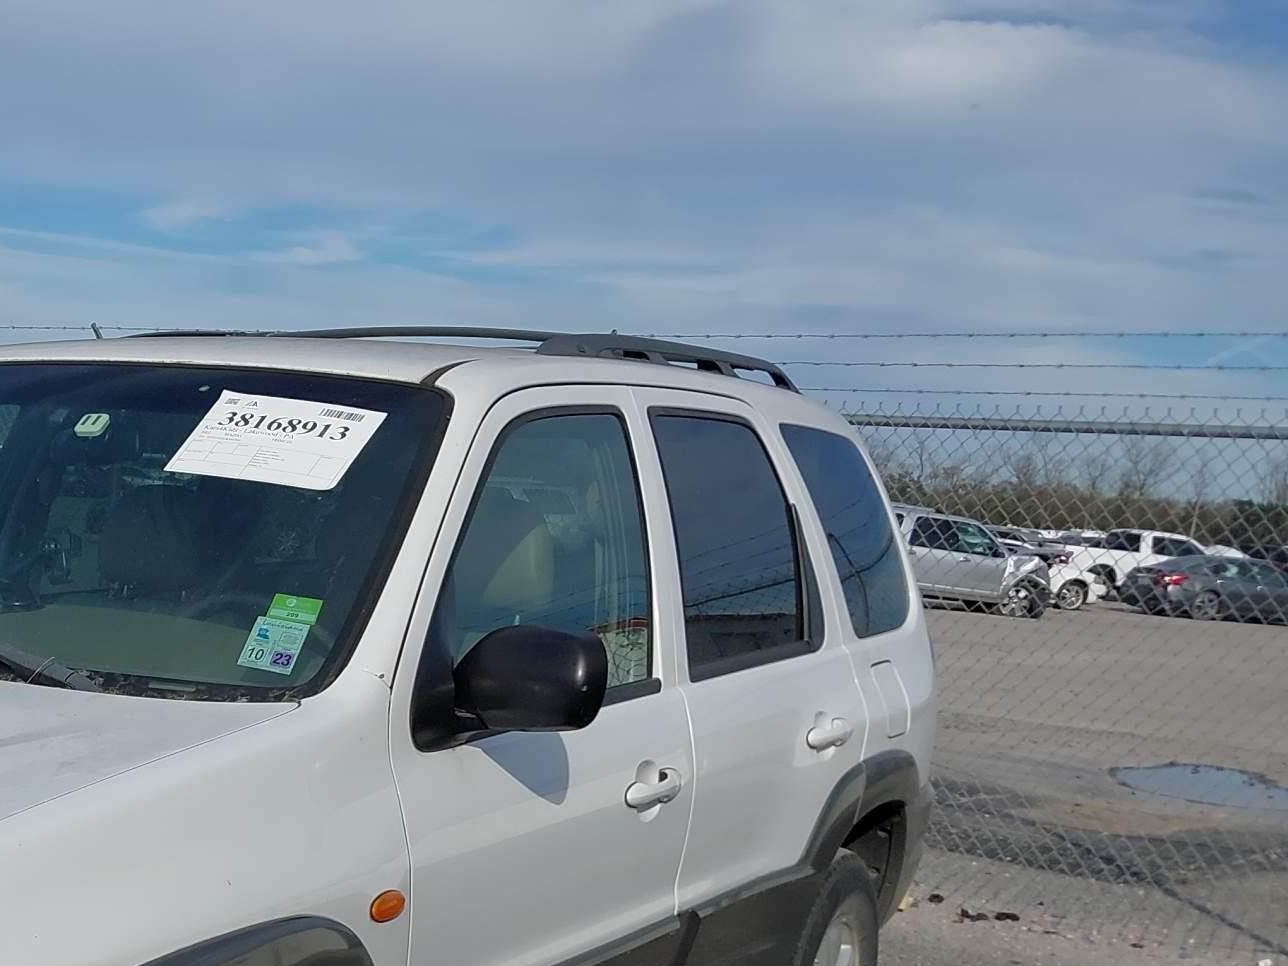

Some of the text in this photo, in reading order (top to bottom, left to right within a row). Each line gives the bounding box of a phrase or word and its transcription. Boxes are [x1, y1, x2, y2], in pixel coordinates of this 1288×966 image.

[217, 411, 350, 441] 38168913
[248, 647, 292, 666] 10 23
